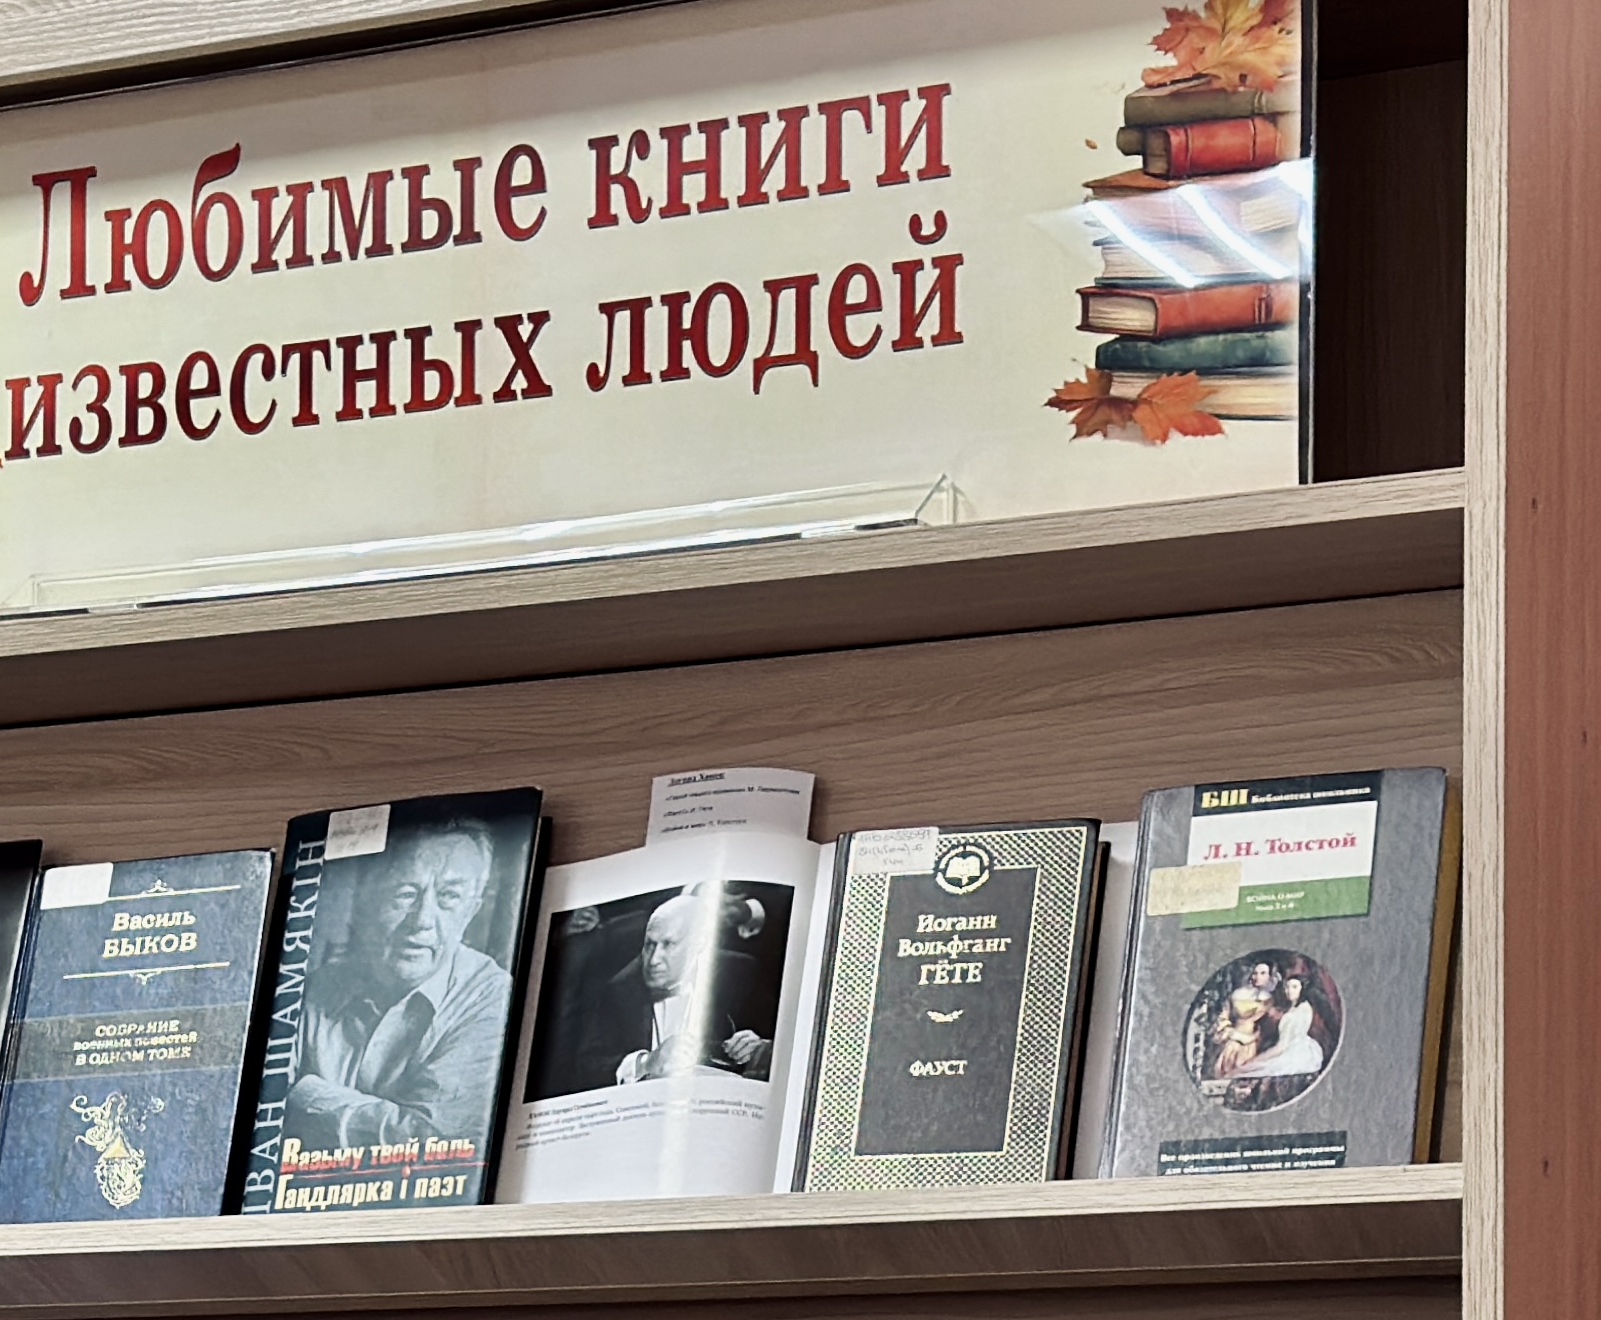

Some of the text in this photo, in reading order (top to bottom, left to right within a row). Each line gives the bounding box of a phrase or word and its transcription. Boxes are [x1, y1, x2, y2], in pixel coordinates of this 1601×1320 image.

[19, 83, 951, 304] Любимые книги
[4, 213, 965, 459] известных людей
[1203, 832, 1357, 861] Л. Н. Толстой
[112, 908, 196, 932] Василь
[915, 912, 997, 936] Иоганн
[102, 931, 198, 958] БЫКОВ
[266, 839, 326, 1078] ШАМЯКІН
[897, 933, 1013, 959] Вольфганг
[918, 958, 985, 987] ГЁТЕ
[95, 1019, 180, 1037] СОБРАНИЕ
[75, 1046, 192, 1066] В ОДНОМ ТОМЕ
[909, 1058, 968, 1078] ФАУСТ
[280, 1136, 476, 1174] Вазьму твой боль
[275, 1174, 394, 1211] Гандлярка
[414, 1175, 468, 1199] паэт
